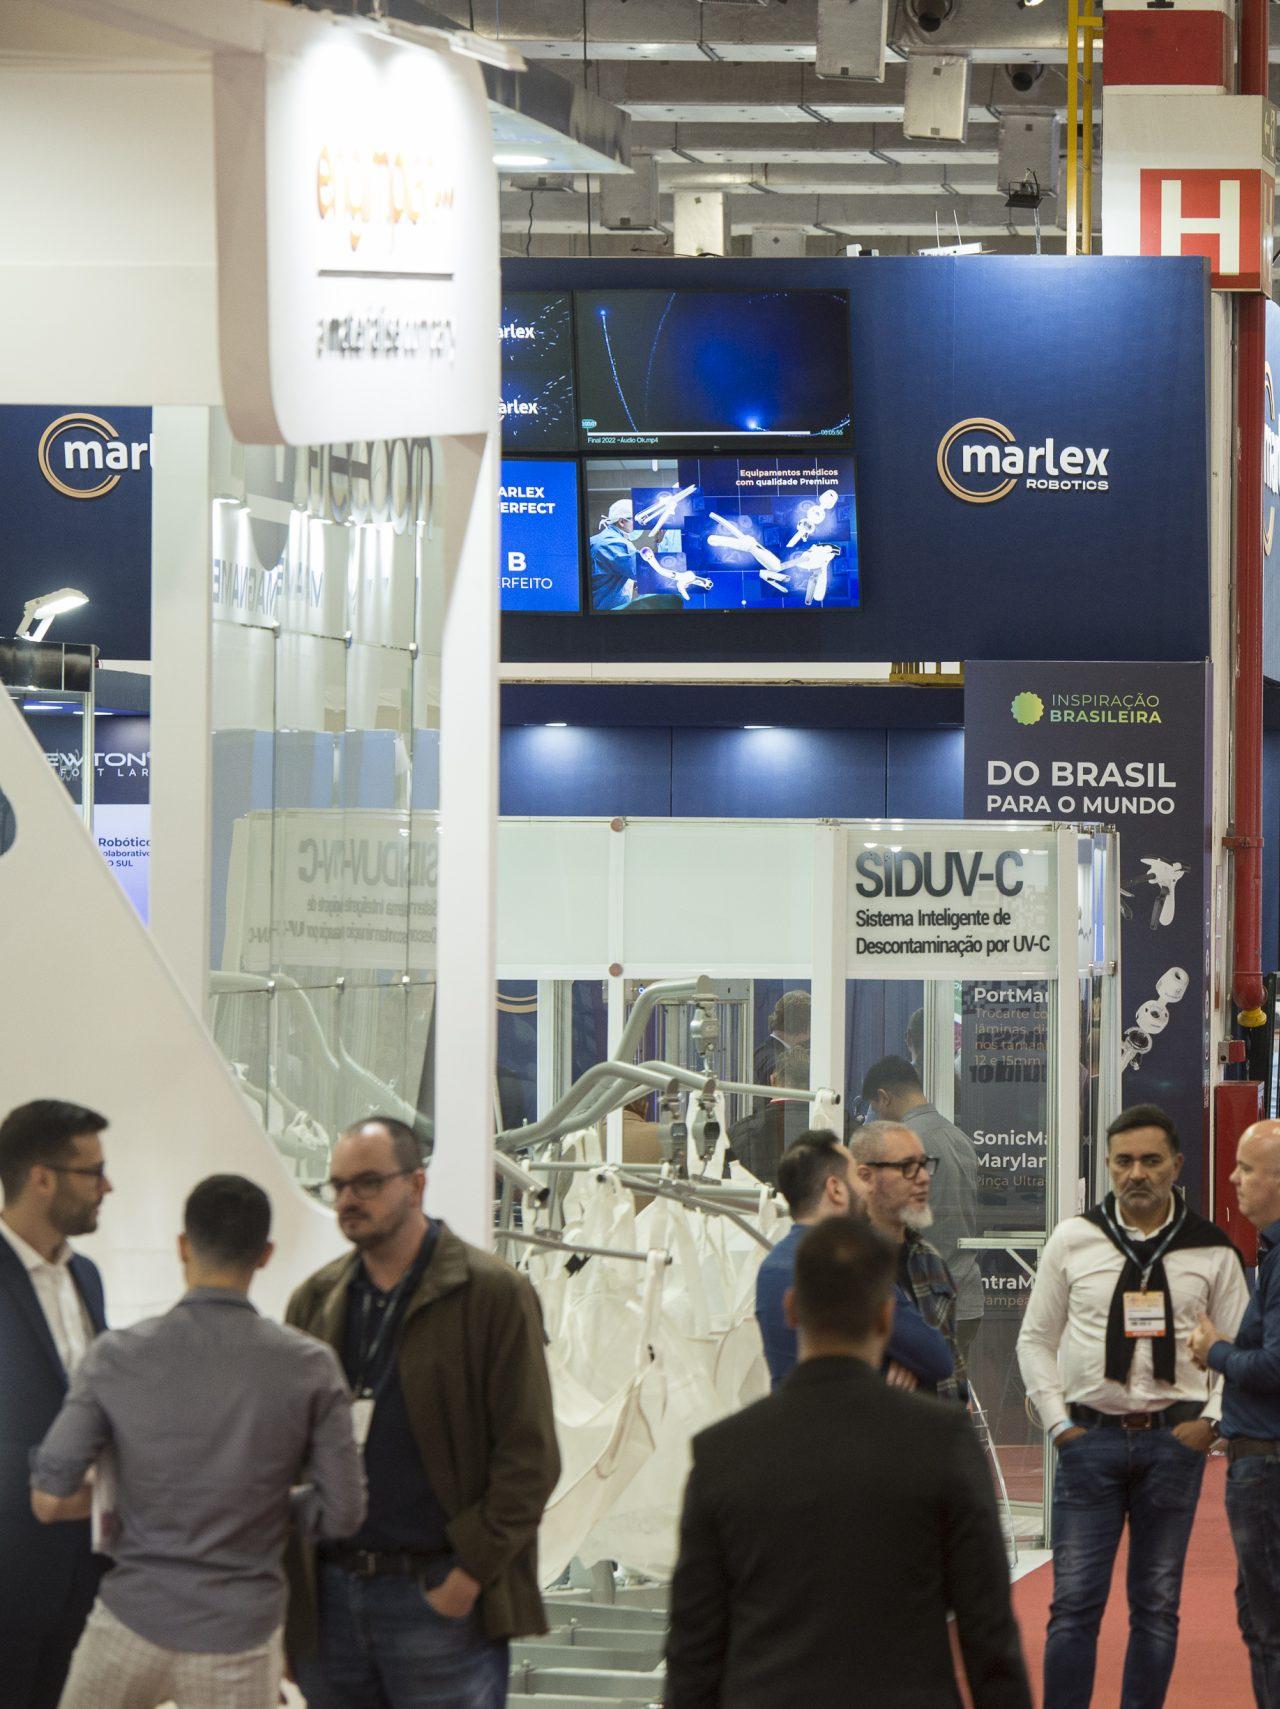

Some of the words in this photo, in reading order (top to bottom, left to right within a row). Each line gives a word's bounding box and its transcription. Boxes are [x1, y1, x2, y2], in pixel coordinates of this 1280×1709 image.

[63, 433, 153, 470] mar
[962, 438, 1109, 477] marlex
[740, 469, 801, 478] Equipamentos
[802, 468, 839, 477] médicos
[756, 478, 798, 487] qualidade
[800, 477, 839, 486] Premium
[498, 486, 545, 498] ARLEX
[1026, 478, 1109, 491] ROBOTICS
[498, 502, 556, 514] ERFECT
[498, 577, 553, 589] RFEITO
[1052, 692, 1160, 711] INSPIRAÇÃO
[1050, 709, 1162, 724] BRASILEIRA
[987, 760, 1040, 786] DO
[1052, 761, 1176, 788] BRASIL
[987, 795, 1051, 813] PARA
[1057, 796, 1076, 814] O
[1083, 796, 1175, 815] MUNDO
[855, 851, 1024, 898] SIDUV-C
[856, 908, 914, 928] Sistema
[917, 908, 990, 932] Inteligente
[993, 908, 1011, 926] de
[856, 935, 983, 957] Descontaminação
[986, 938, 1009, 958] por
[1013, 935, 1051, 954] UV-C
